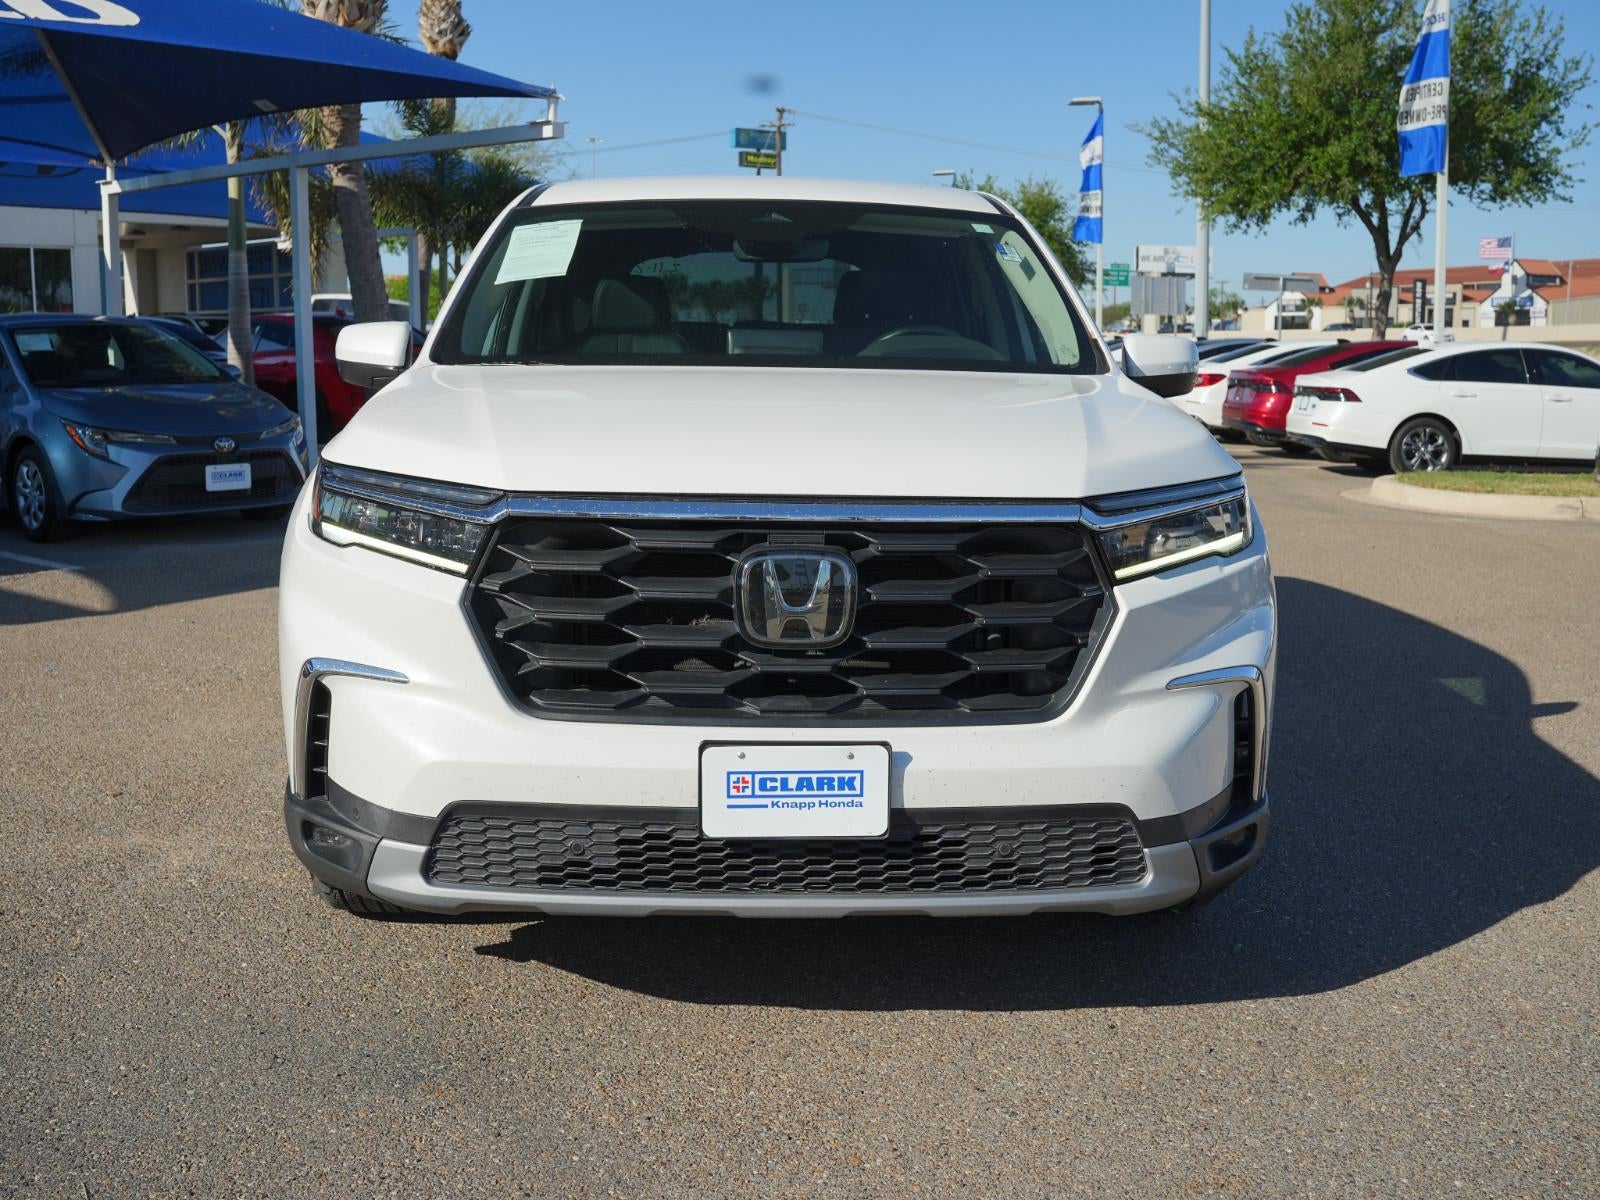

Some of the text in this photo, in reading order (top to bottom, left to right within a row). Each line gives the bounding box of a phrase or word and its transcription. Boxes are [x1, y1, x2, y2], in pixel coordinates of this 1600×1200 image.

[758, 776, 857, 792] CLARK
[771, 799, 863, 810] Knapp Honda
